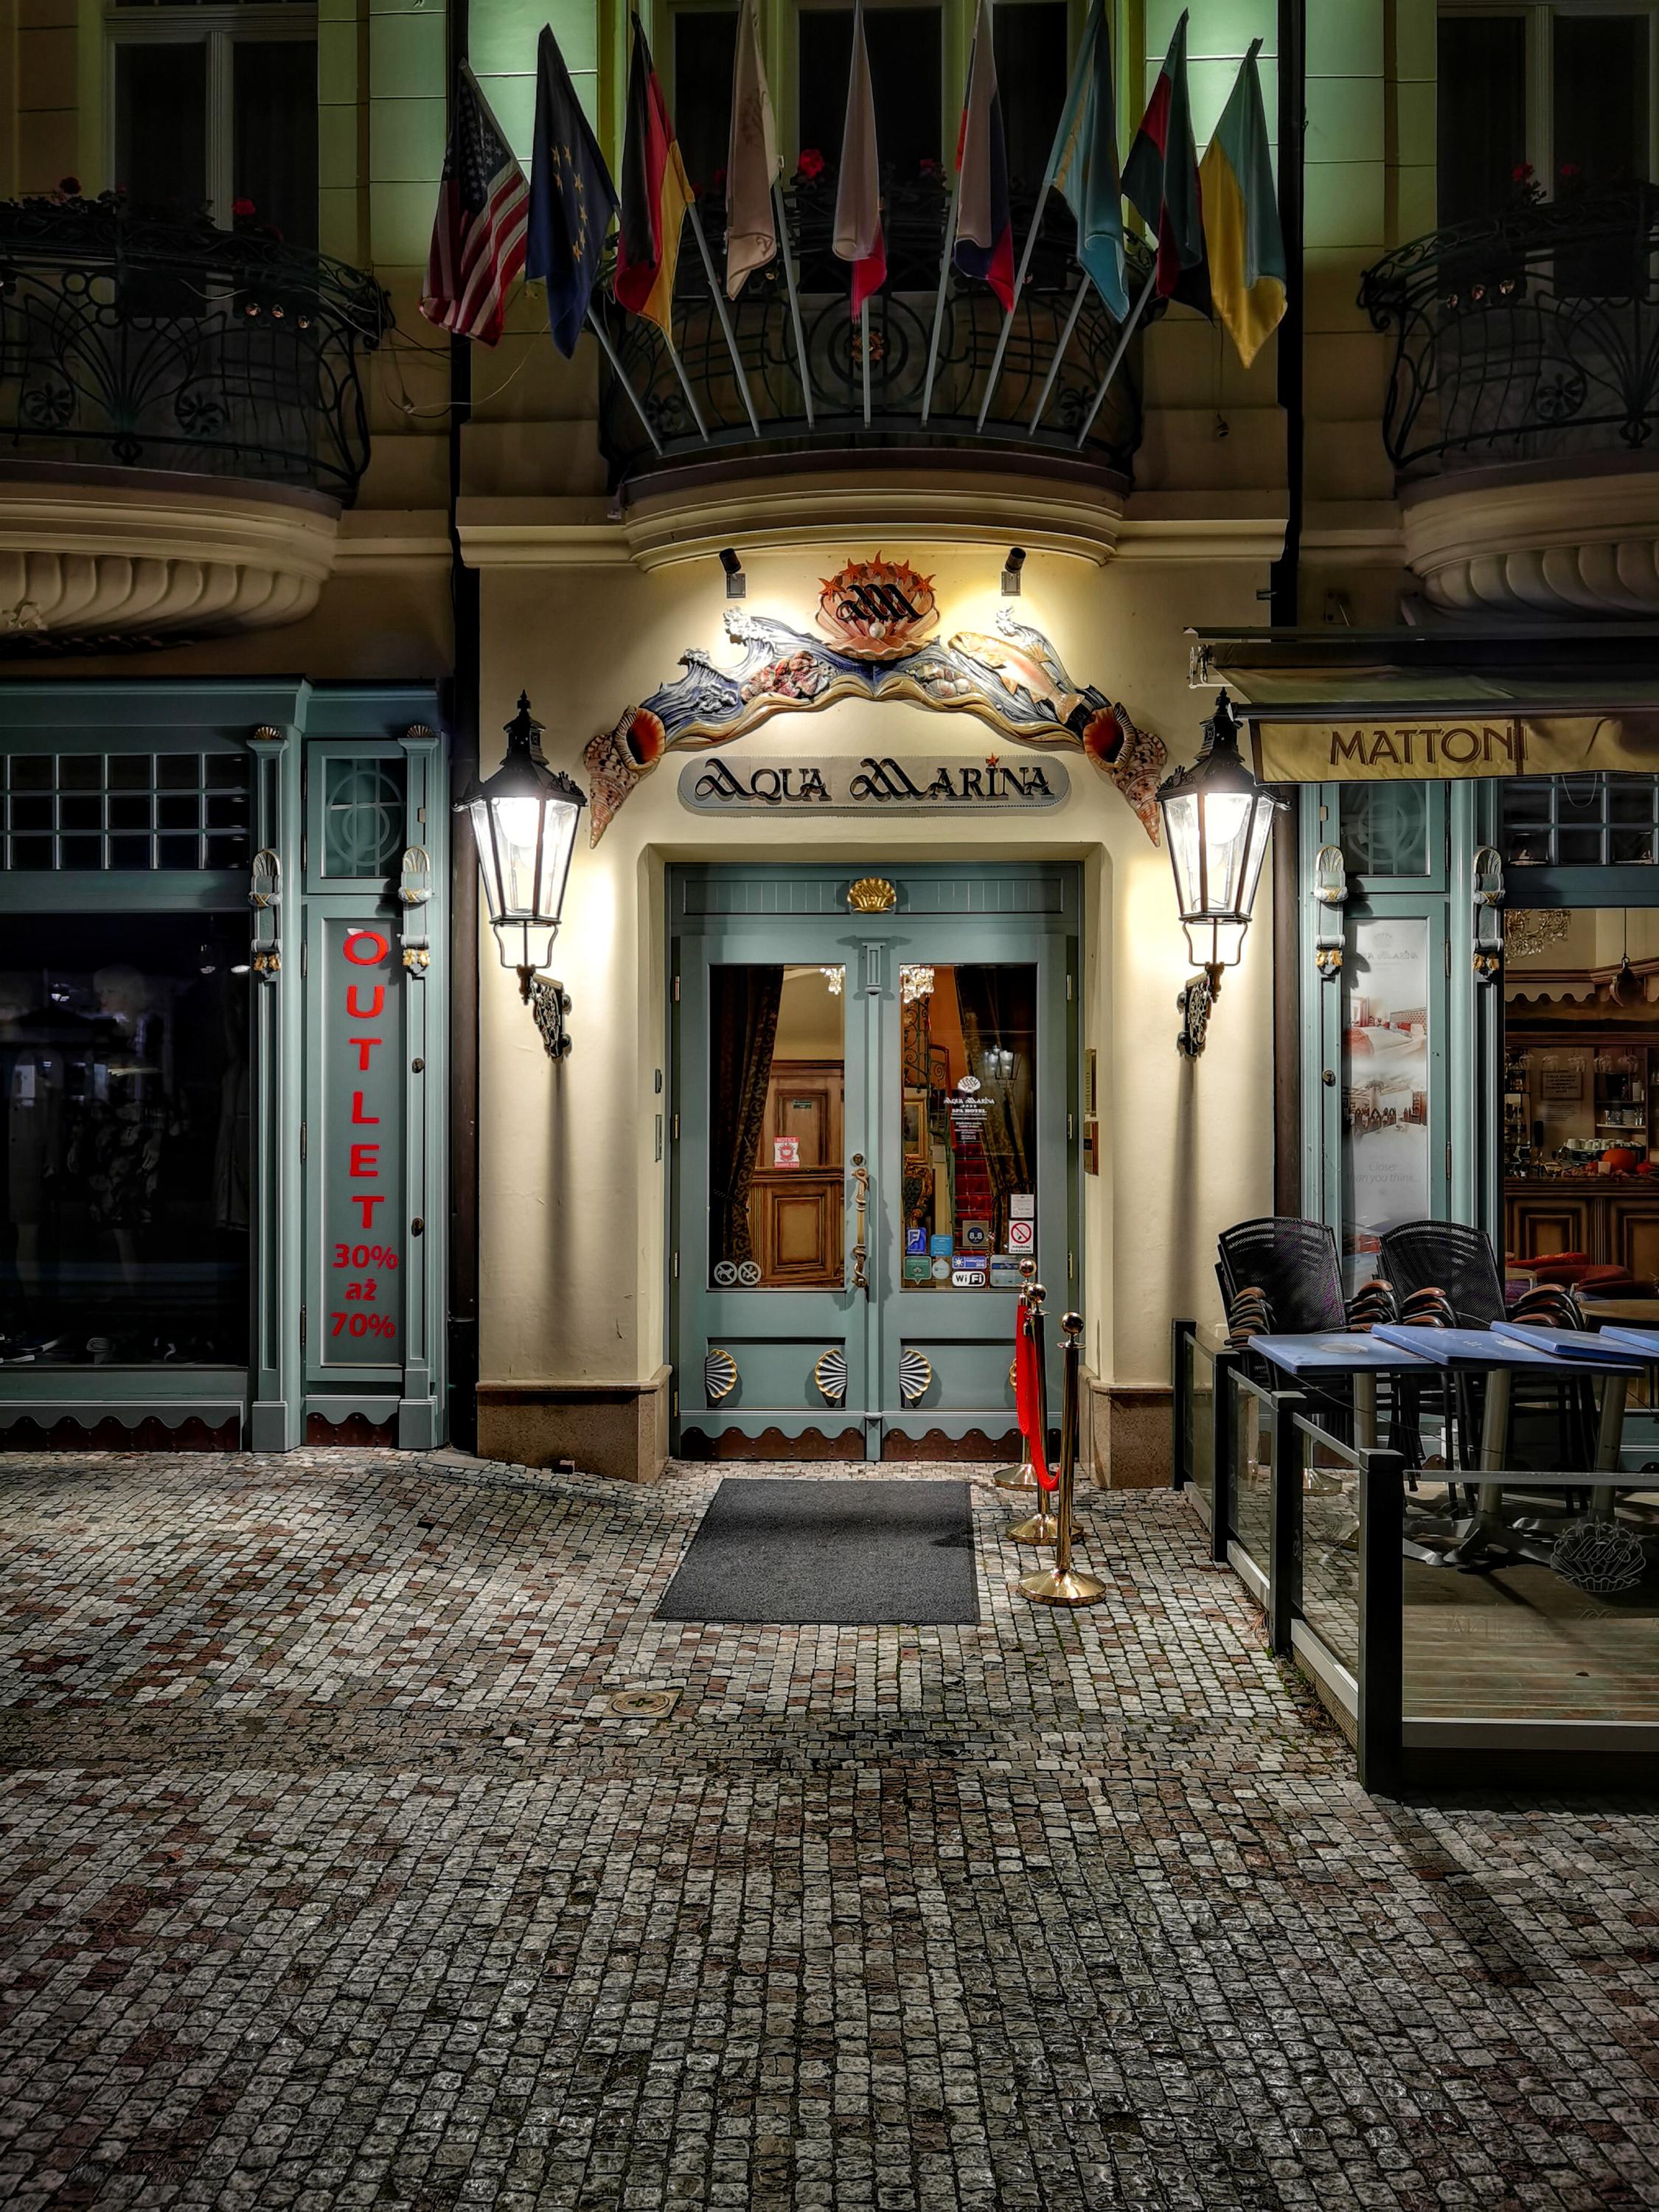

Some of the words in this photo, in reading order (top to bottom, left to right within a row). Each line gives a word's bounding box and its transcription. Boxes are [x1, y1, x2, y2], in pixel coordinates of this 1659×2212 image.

[695, 758, 832, 801] AQUA
[849, 754, 1054, 801] MARINA
[343, 931, 388, 1229] OUTLET
[965, 1096, 995, 1105] MARINA
[969, 1232, 983, 1241] 8,8
[332, 1242, 399, 1270] 30%
[344, 1278, 378, 1301] až
[330, 1312, 396, 1338] 70%
